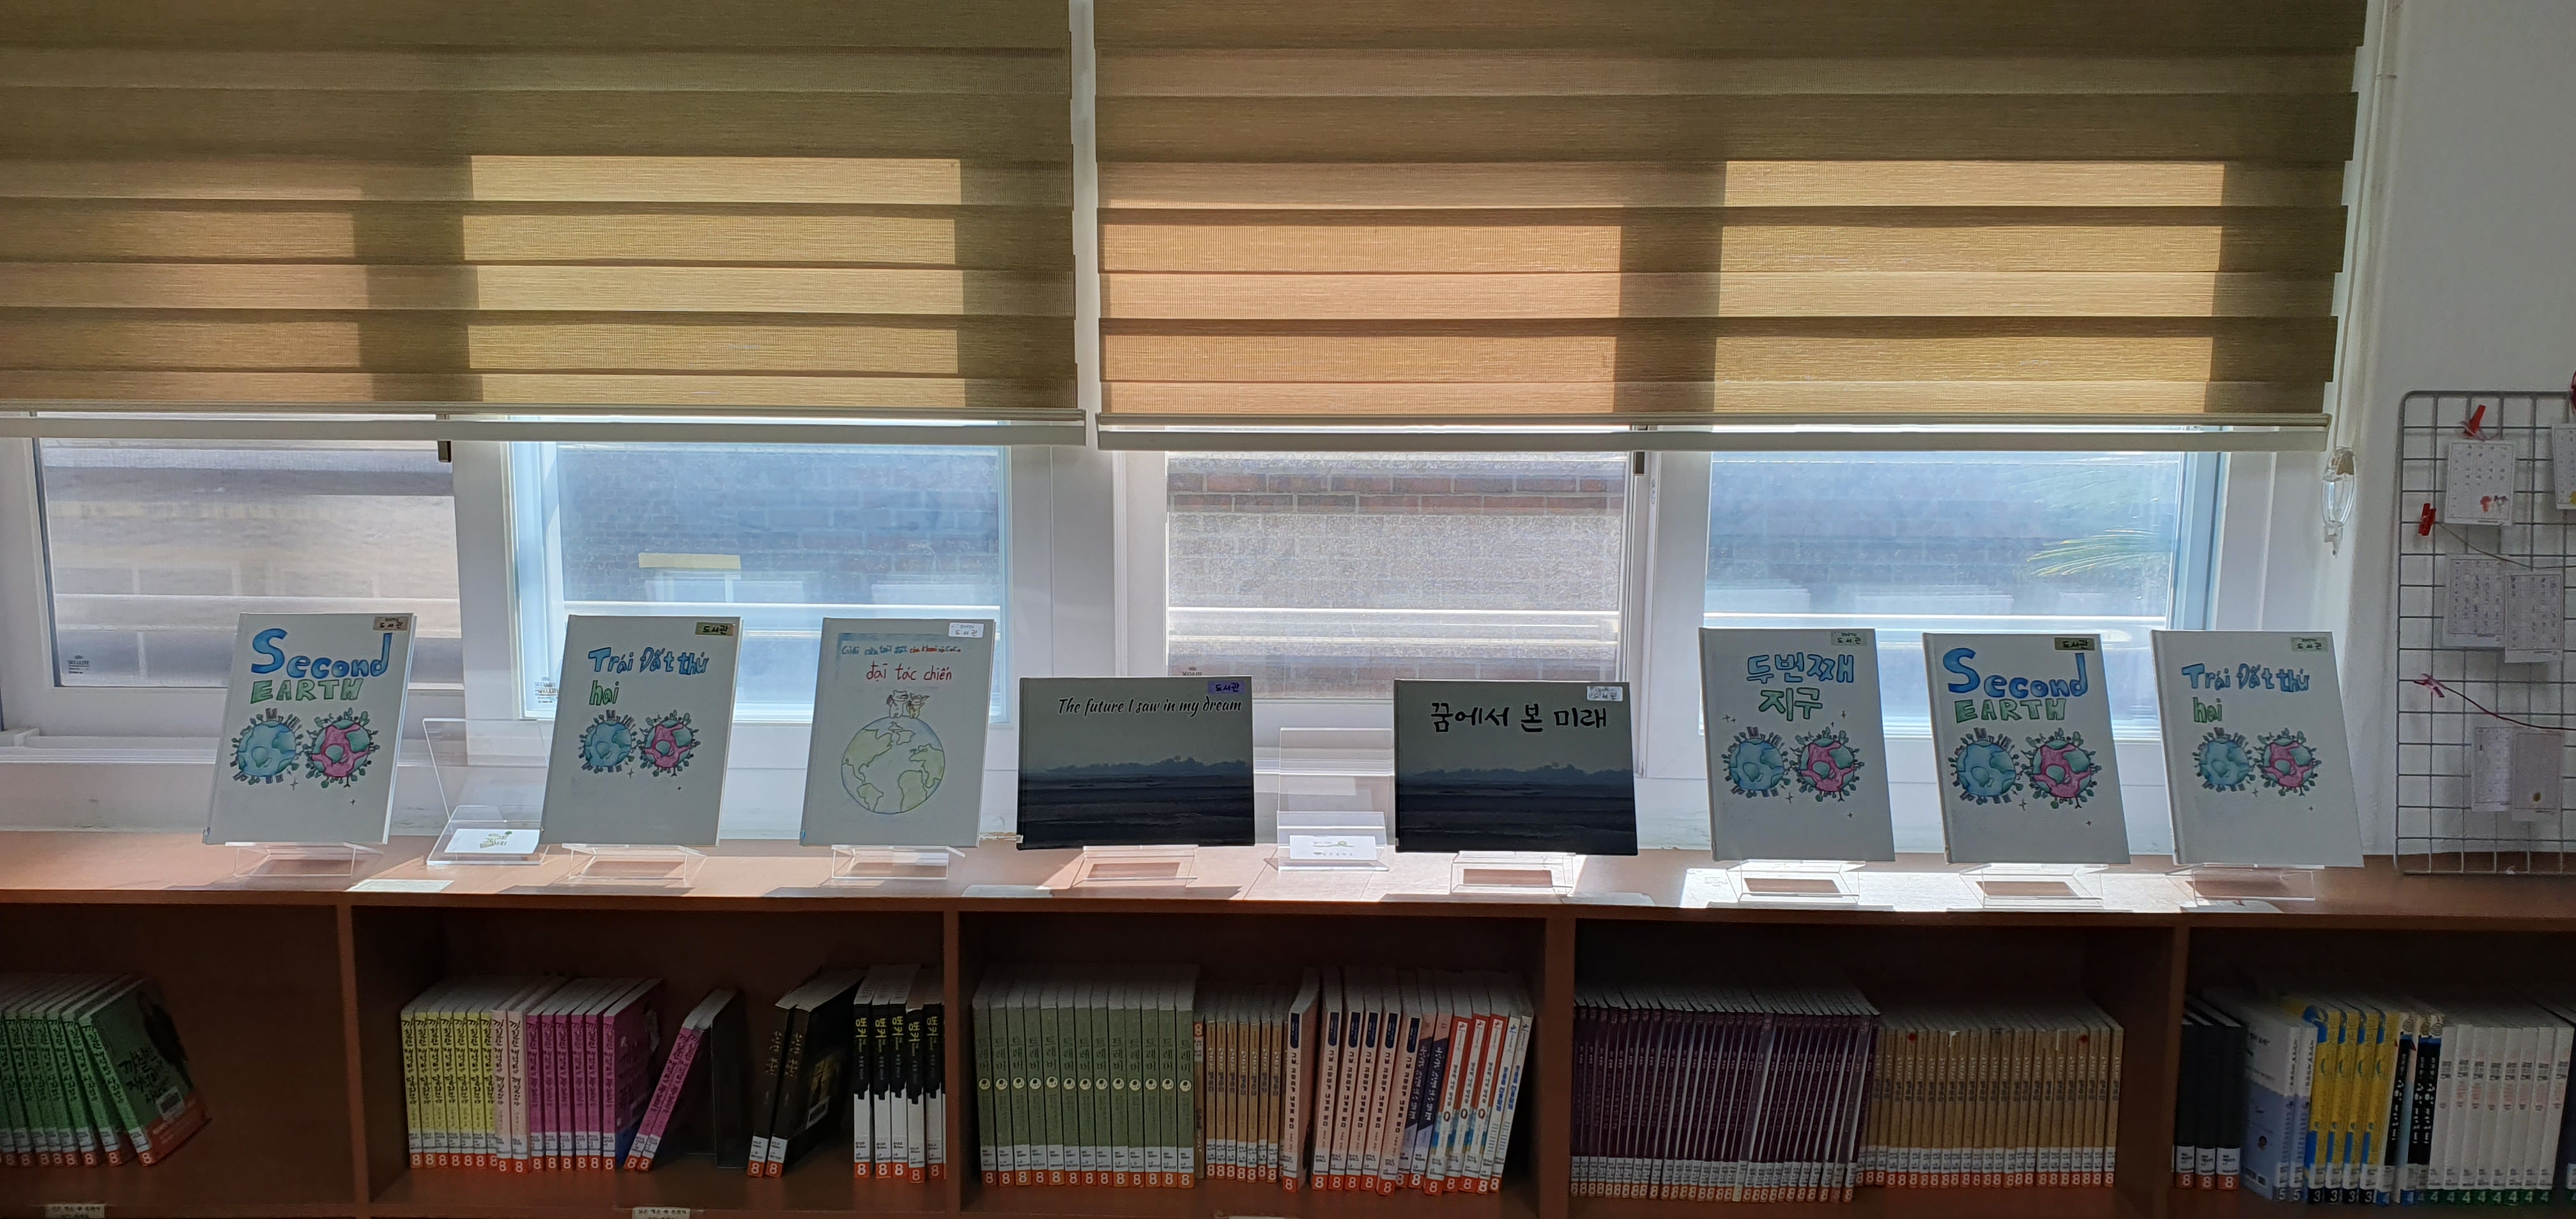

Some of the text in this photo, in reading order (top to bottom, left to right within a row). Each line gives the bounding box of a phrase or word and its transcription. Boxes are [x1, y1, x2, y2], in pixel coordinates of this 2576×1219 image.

[702, 625, 728, 634] 도서관
[2062, 640, 2089, 649] 도서관
[251, 629, 392, 679] Second
[1746, 650, 1856, 685] 두번째
[1942, 647, 2090, 699] Second
[250, 678, 364, 705] EARTH
[1215, 682, 1239, 692] 도서관
[588, 680, 619, 706] hai
[1593, 692, 1616, 700] 도서관
[1057, 697, 1243, 719] The future I saw in my dream
[1758, 687, 1825, 722] 지구
[2193, 697, 2223, 723] hai
[1954, 699, 2067, 724] EARTH
[1430, 702, 1609, 733] 꿈에서 본 미래
[22, 1154, 30, 1165] 8
[85, 1154, 93, 1164] 8
[109, 1153, 118, 1163] 8
[142, 1153, 151, 1163] 8
[413, 1154, 420, 1165] 8
[426, 1154, 434, 1165] 8
[452, 1155, 459, 1166] 8
[464, 1155, 472, 1166] 8
[549, 1158, 556, 1169] 8
[591, 1158, 599, 1169] 8
[500, 1161, 506, 1171] 8
[516, 1162, 523, 1172] 8
[533, 1159, 541, 1169] 8
[606, 1159, 613, 1169] 8
[751, 1163, 759, 1174] 8
[770, 1163, 777, 1174] 8
[857, 1164, 866, 1175] 8
[879, 1164, 887, 1175] 8
[895, 1164, 903, 1175] 8
[912, 1170, 920, 1180] 8
[1208, 1165, 1215, 1176] 8
[1227, 1166, 1234, 1177] 8
[1248, 1169, 1255, 1180] 8
[1268, 1170, 1276, 1180] 8
[986, 1172, 993, 1183] 8
[1019, 1172, 1027, 1183] 8
[1053, 1172, 1060, 1183] 8
[1101, 1173, 1108, 1184] 8
[1149, 1174, 1157, 1184] 8
[1182, 1174, 1189, 1185] 8
[1315, 1177, 1323, 1188] 8
[1349, 1177, 1356, 1188] 8
[2203, 1177, 2211, 1187] 8
[2225, 1176, 2233, 1188] 8
[1285, 1179, 1292, 1190] 8
[1384, 1182, 1392, 1193] 8
[1430, 1182, 1438, 1192] 8
[1464, 1179, 1471, 1189] 8
[1491, 1178, 1499, 1190] 8
[2279, 1189, 2285, 1200] 5
[2294, 1189, 2300, 1200] 5
[2314, 1191, 2320, 1202] 3
[2331, 1190, 2337, 1201] 3
[2349, 1191, 2355, 1202] 3
[2365, 1190, 2372, 1202] 3
